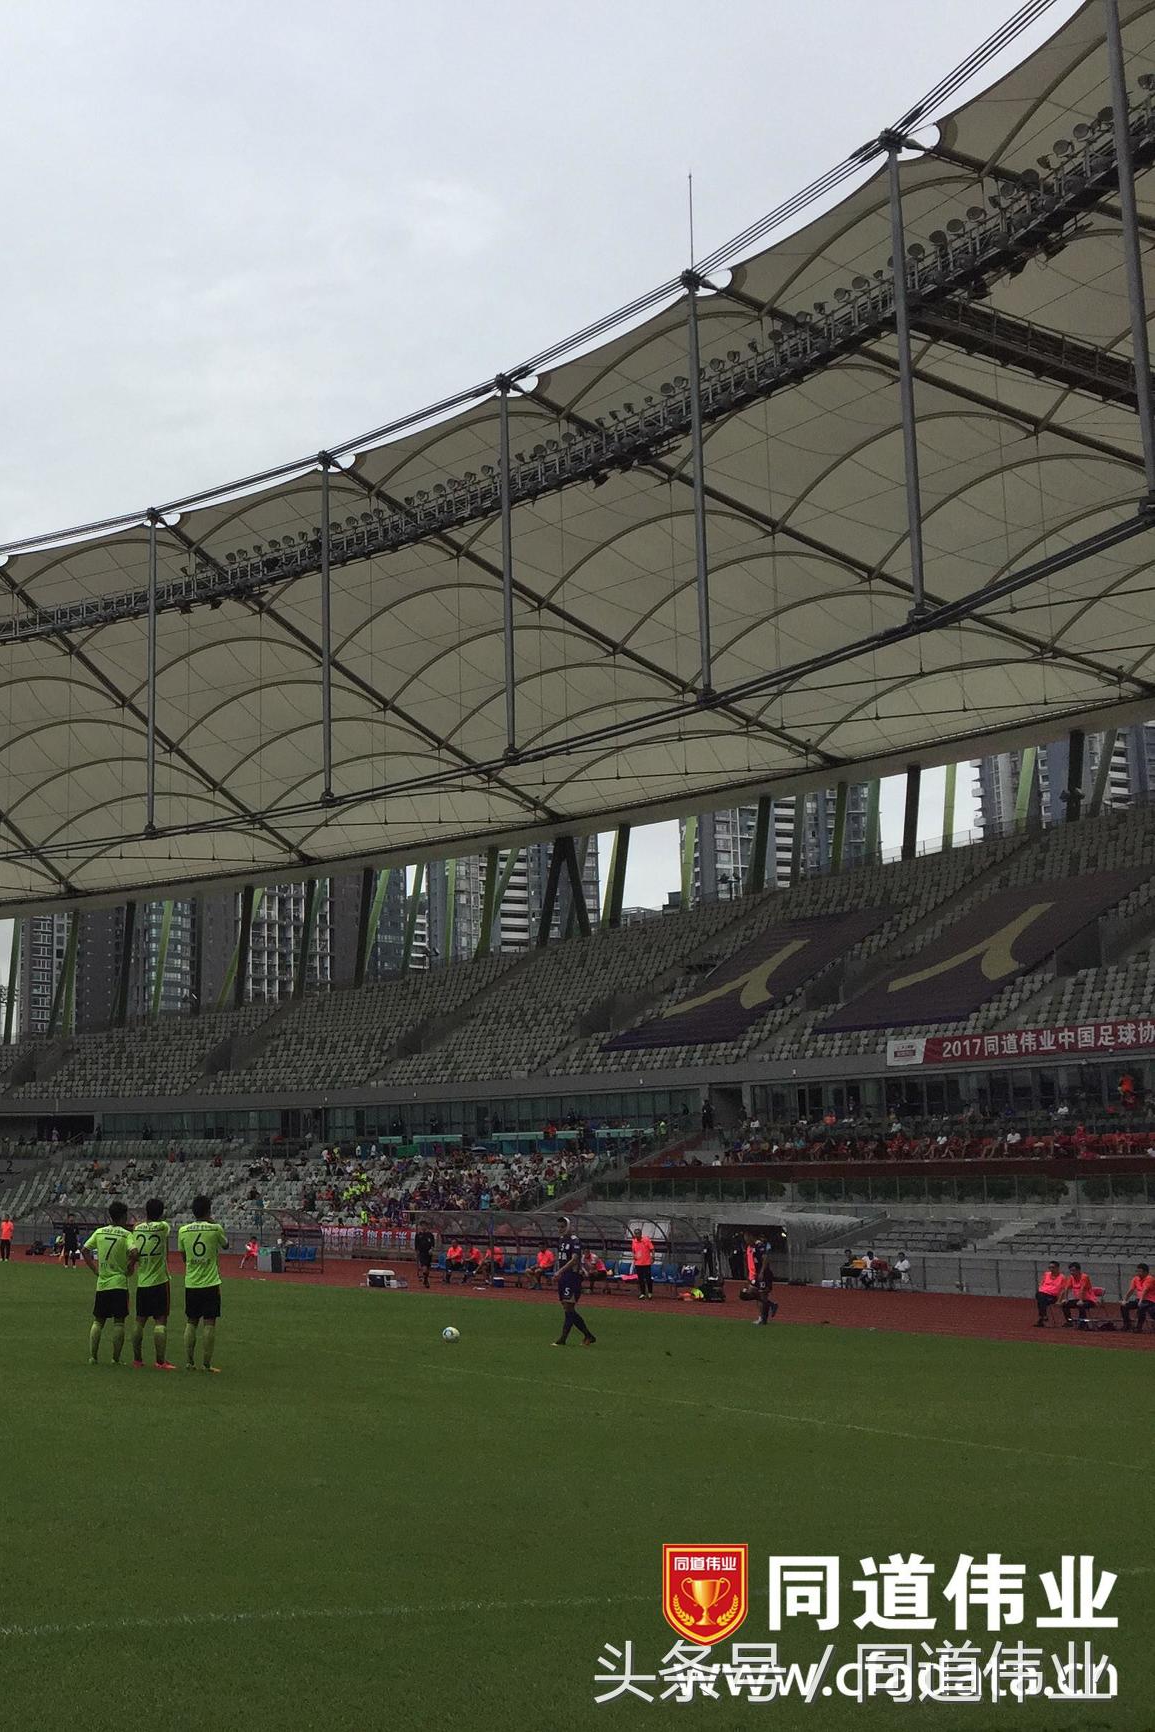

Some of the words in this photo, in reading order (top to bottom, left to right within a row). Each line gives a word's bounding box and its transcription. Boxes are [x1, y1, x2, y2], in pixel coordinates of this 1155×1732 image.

[942, 1021, 1155, 1057] 2017同道伟业中国足球协
[104, 1237, 118, 1261] 7
[135, 1234, 162, 1257] 22
[192, 1233, 206, 1257] 6
